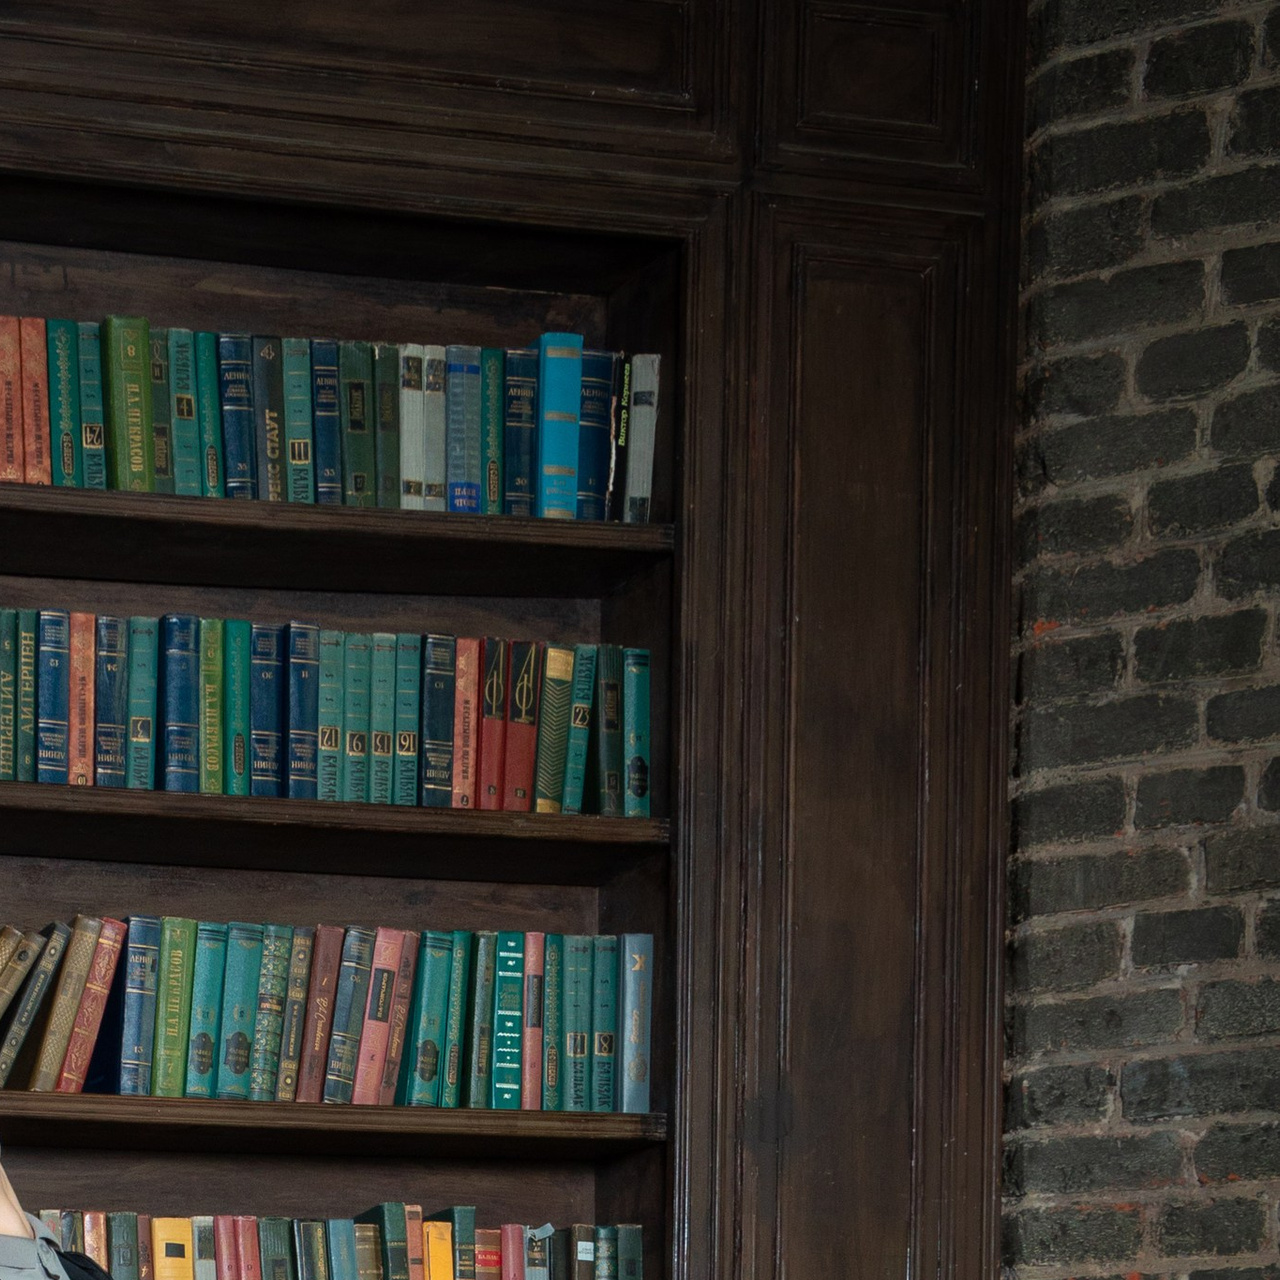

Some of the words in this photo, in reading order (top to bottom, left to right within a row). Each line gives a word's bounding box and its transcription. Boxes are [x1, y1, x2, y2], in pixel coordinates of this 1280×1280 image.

[175, 341, 191, 391] БАЛЬЗАК
[180, 399, 190, 415] 4
[85, 426, 103, 445] 24
[265, 408, 279, 460] СТАУТ
[618, 409, 628, 447] Виктор
[86, 453, 103, 489] БАЛЬЗ
[293, 467, 311, 502] БАЛЬЗ
[20, 631, 35, 736] А.И.ГЕРЦЕН
[575, 654, 595, 700] БАЛЬЗАК
[0, 670, 14, 775] А.И.ГЕРЦЕН
[575, 705, 590, 726] 23
[322, 728, 337, 748] 12
[352, 735, 363, 752] 9
[376, 734, 390, 752] 13
[400, 733, 416, 752] 16
[39, 749, 66, 760] ЛЕНИН
[97, 754, 126, 765] ЛЕНИН
[133, 746, 150, 787] БАЛЬЗА
[253, 760, 278, 770] ЛЕНИН
[291, 760, 315, 771] ЛЕНИН
[348, 760, 364, 801] БАЛЬЗА
[374, 758, 389, 803] БАЛЬЗА
[399, 758, 415, 804] БАЛЬЗА
[426, 768, 450, 778] ЛЕНИН
[166, 949, 183, 1037] Н.А.НЕКРАСОВ
[601, 1034, 613, 1053] 8
